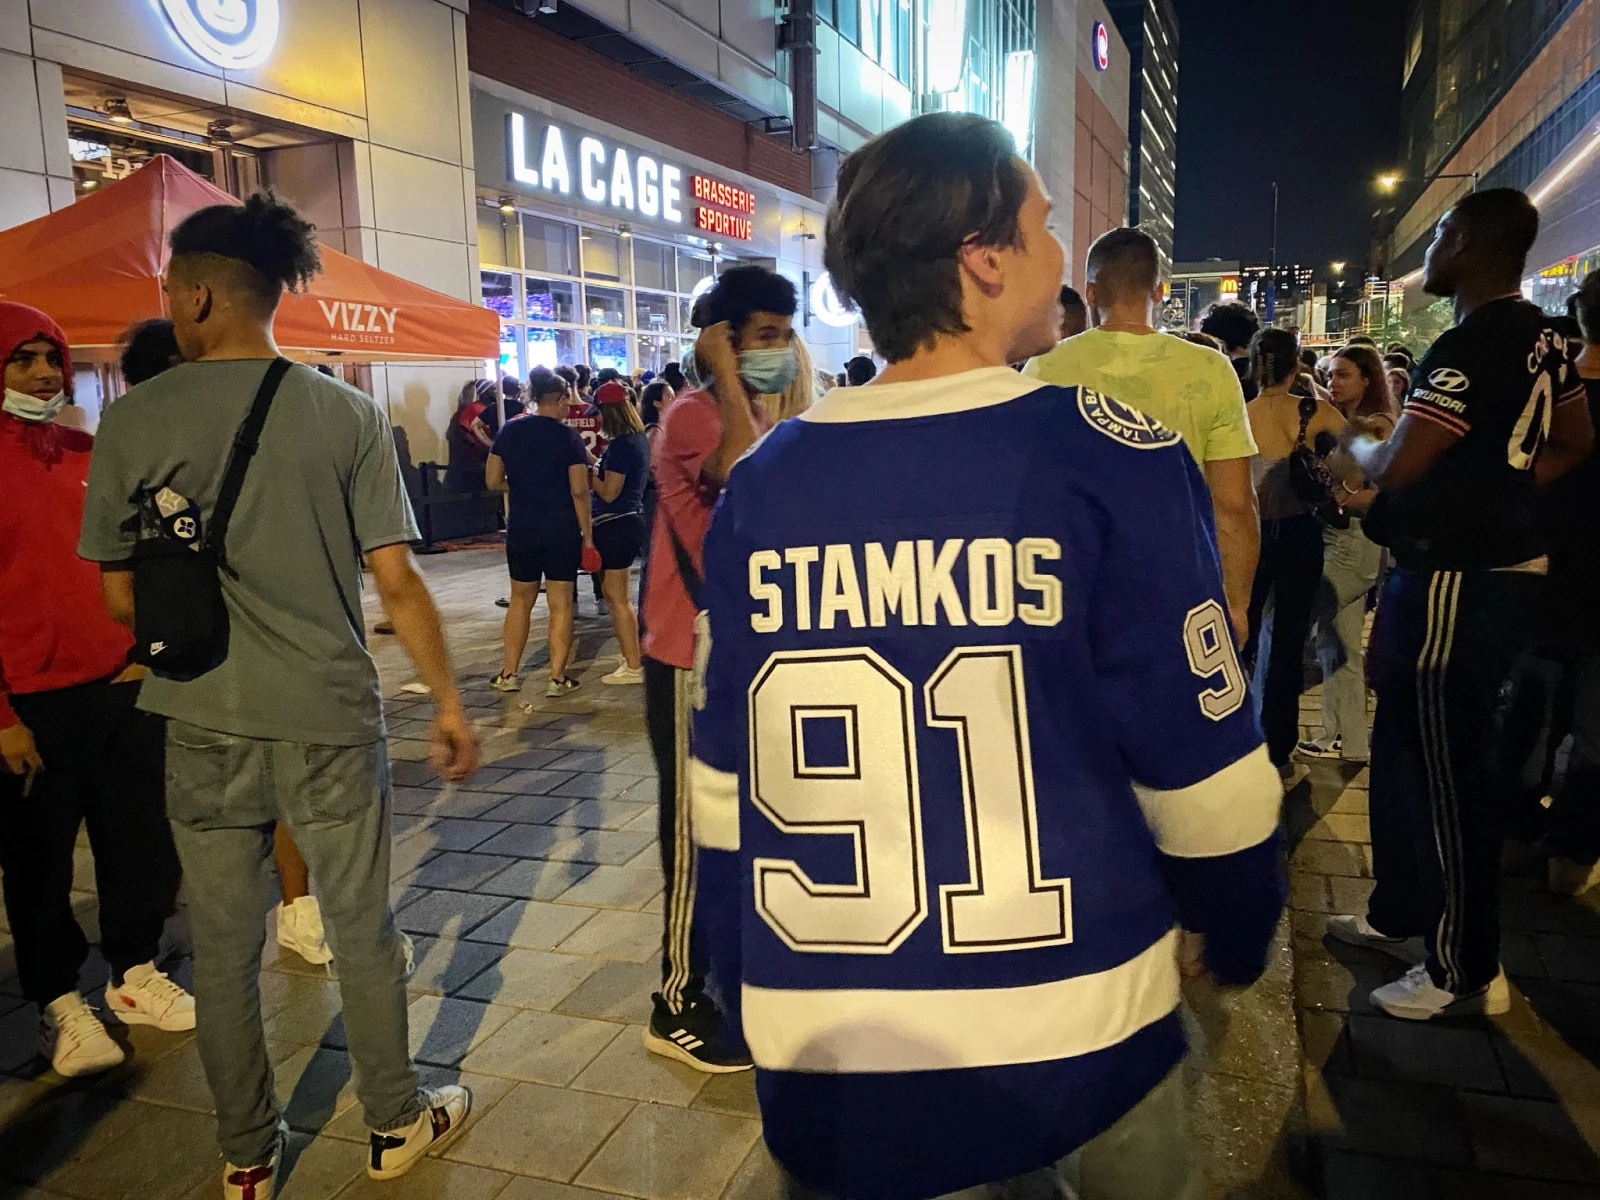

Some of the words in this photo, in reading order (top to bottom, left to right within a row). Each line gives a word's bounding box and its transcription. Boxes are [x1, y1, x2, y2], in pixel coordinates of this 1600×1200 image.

[511, 111, 570, 194] LA
[580, 136, 682, 223] CAGE
[694, 175, 756, 215] BRASSERIE
[698, 207, 752, 241] SPORTIVE
[317, 299, 400, 333] VIZZY
[331, 333, 356, 342] HARD
[359, 335, 395, 345] SELTZER
[1090, 407, 1141, 442] TAMPA
[748, 537, 1063, 633] STAMKOS
[1183, 598, 1246, 721] 9
[748, 644, 1073, 954] 91
